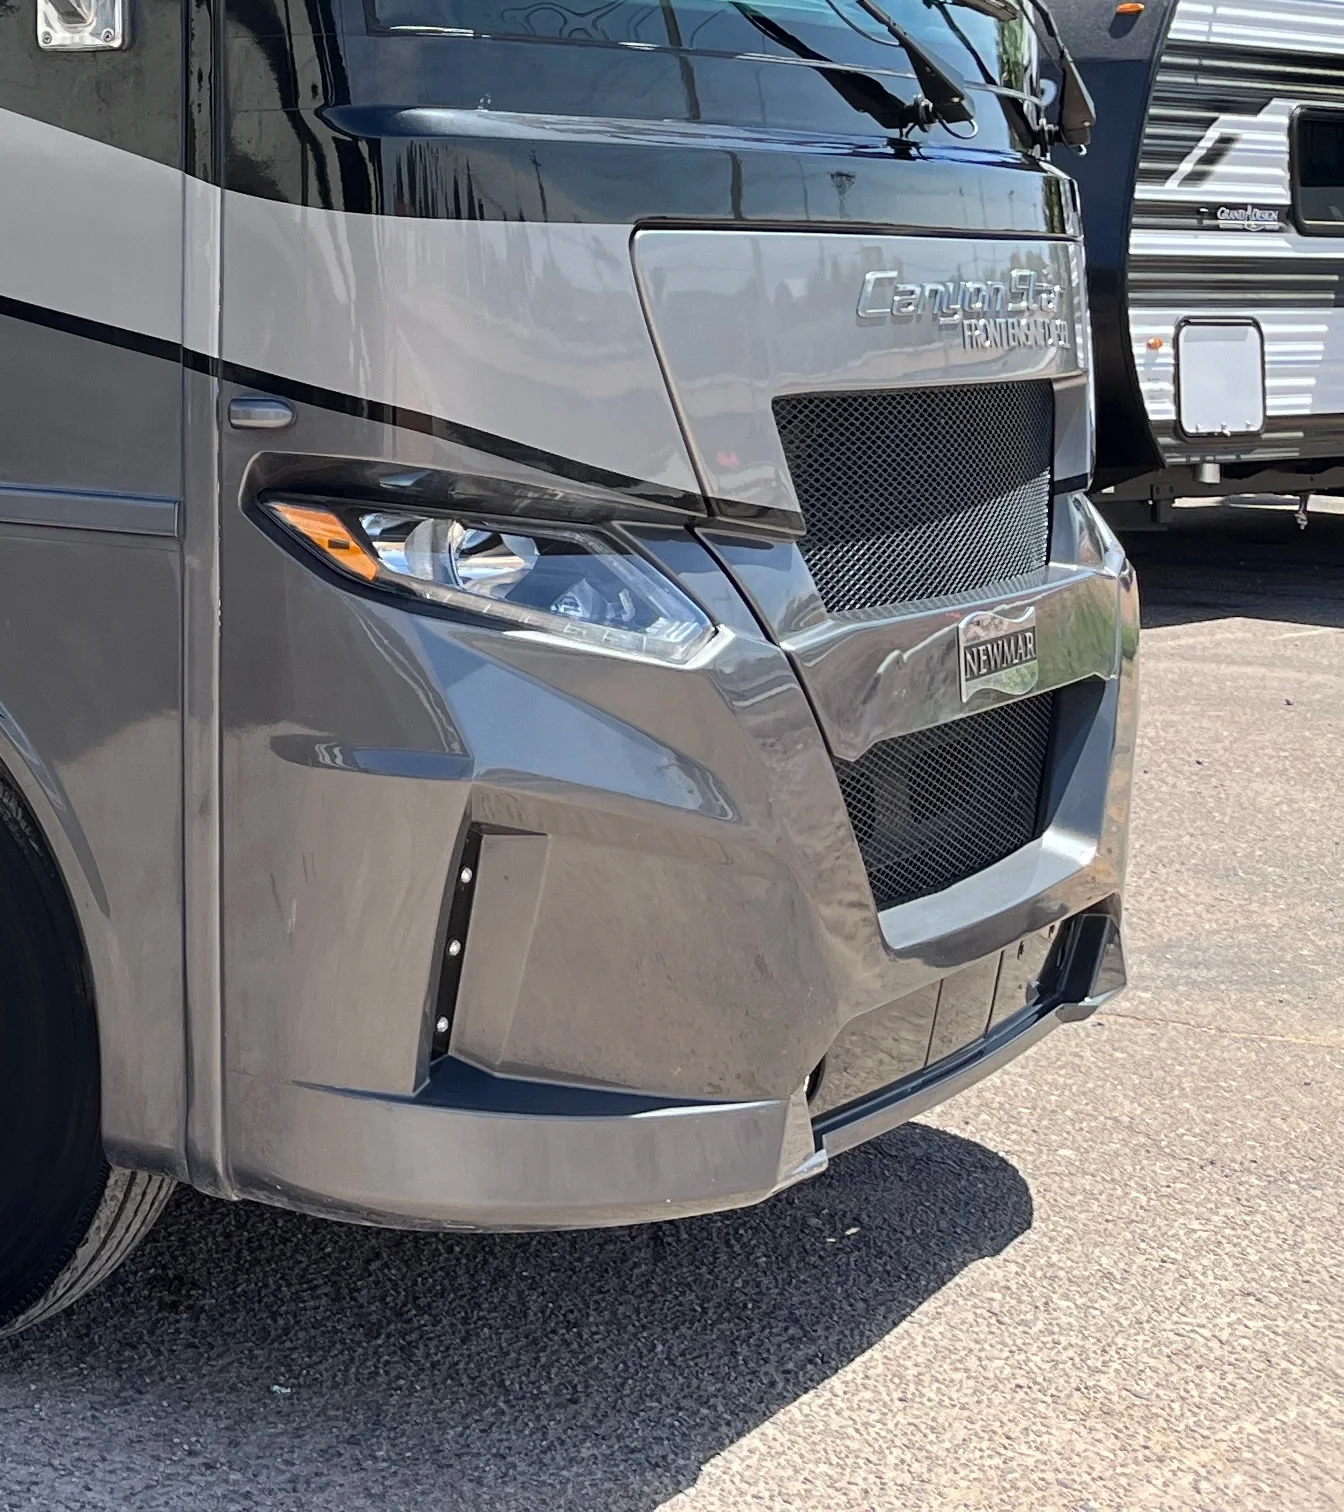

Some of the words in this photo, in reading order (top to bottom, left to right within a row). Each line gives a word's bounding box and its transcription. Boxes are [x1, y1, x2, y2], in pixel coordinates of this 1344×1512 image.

[1217, 207, 1246, 220] GRAND
[1252, 208, 1279, 221] DESIGN
[857, 271, 1006, 325] Canyon
[963, 318, 1007, 350] FRONT
[964, 631, 1037, 679] NEWMAR
